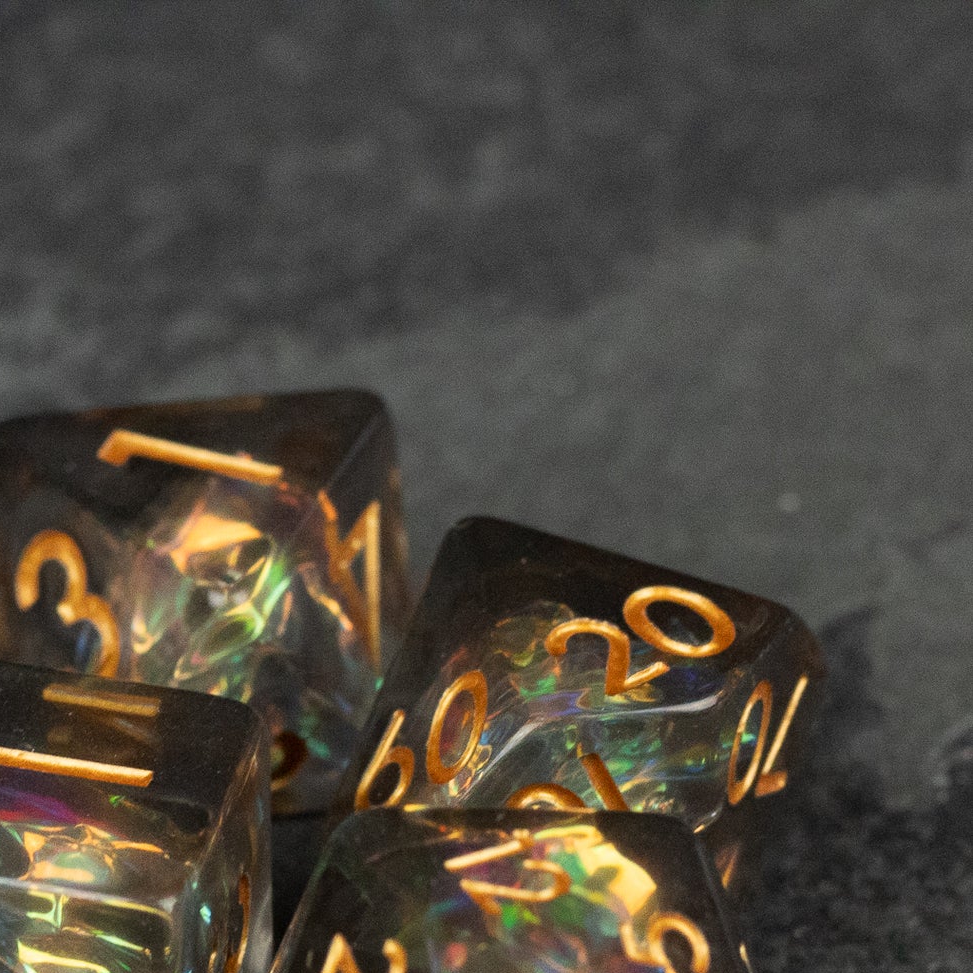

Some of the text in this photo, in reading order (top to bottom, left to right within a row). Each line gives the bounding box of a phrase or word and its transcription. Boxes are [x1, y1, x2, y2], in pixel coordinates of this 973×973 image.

[97, 429, 283, 485] 1
[16, 530, 120, 678] 3
[544, 584, 736, 696] 20
[355, 670, 488, 811] 60
